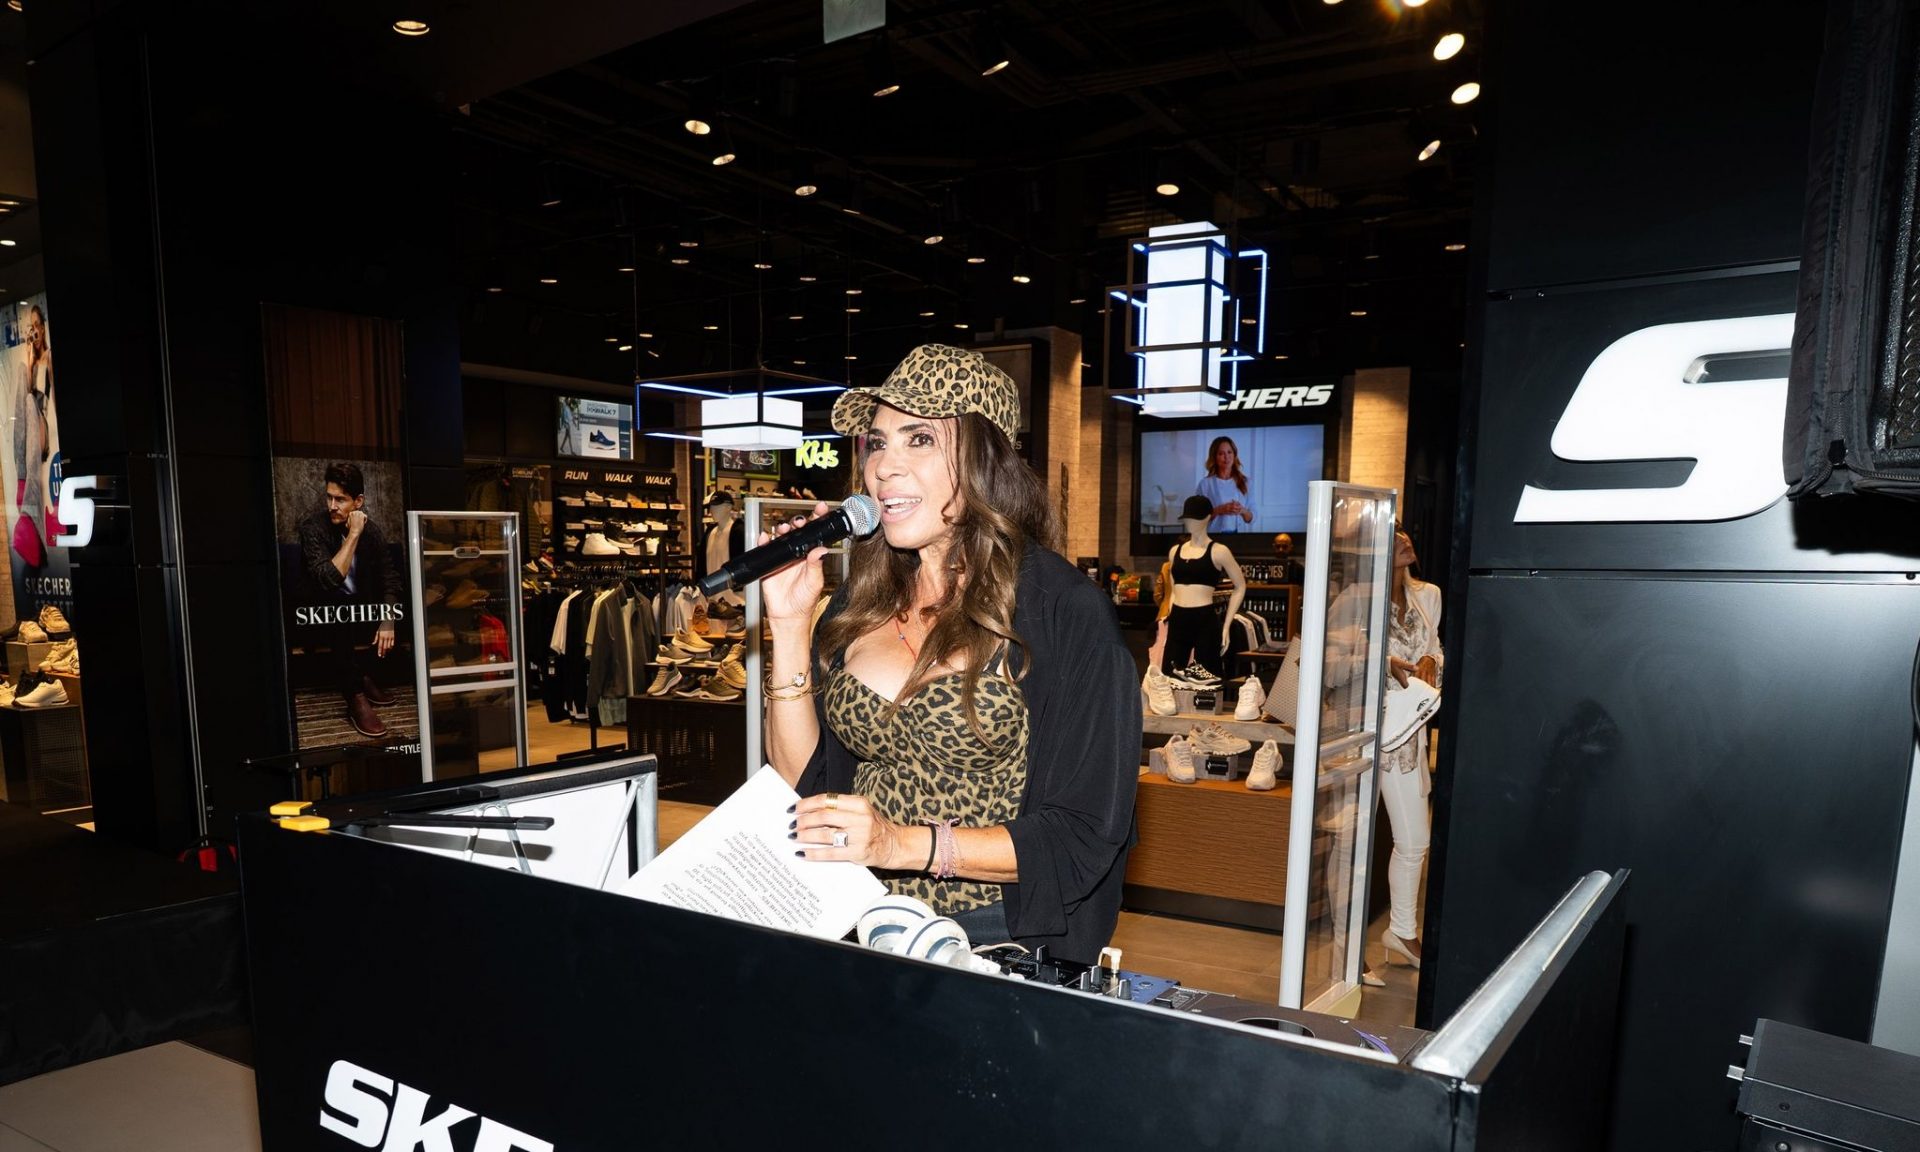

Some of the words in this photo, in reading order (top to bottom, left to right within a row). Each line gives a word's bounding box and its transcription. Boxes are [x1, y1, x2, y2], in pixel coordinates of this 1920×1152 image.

[1513, 312, 1797, 524] S
[795, 440, 840, 469] Kids
[564, 470, 589, 481] RUN
[605, 472, 634, 483] WALK
[645, 475, 672, 485] WALK
[56, 475, 97, 547] S
[295, 602, 404, 625] SKECHERS
